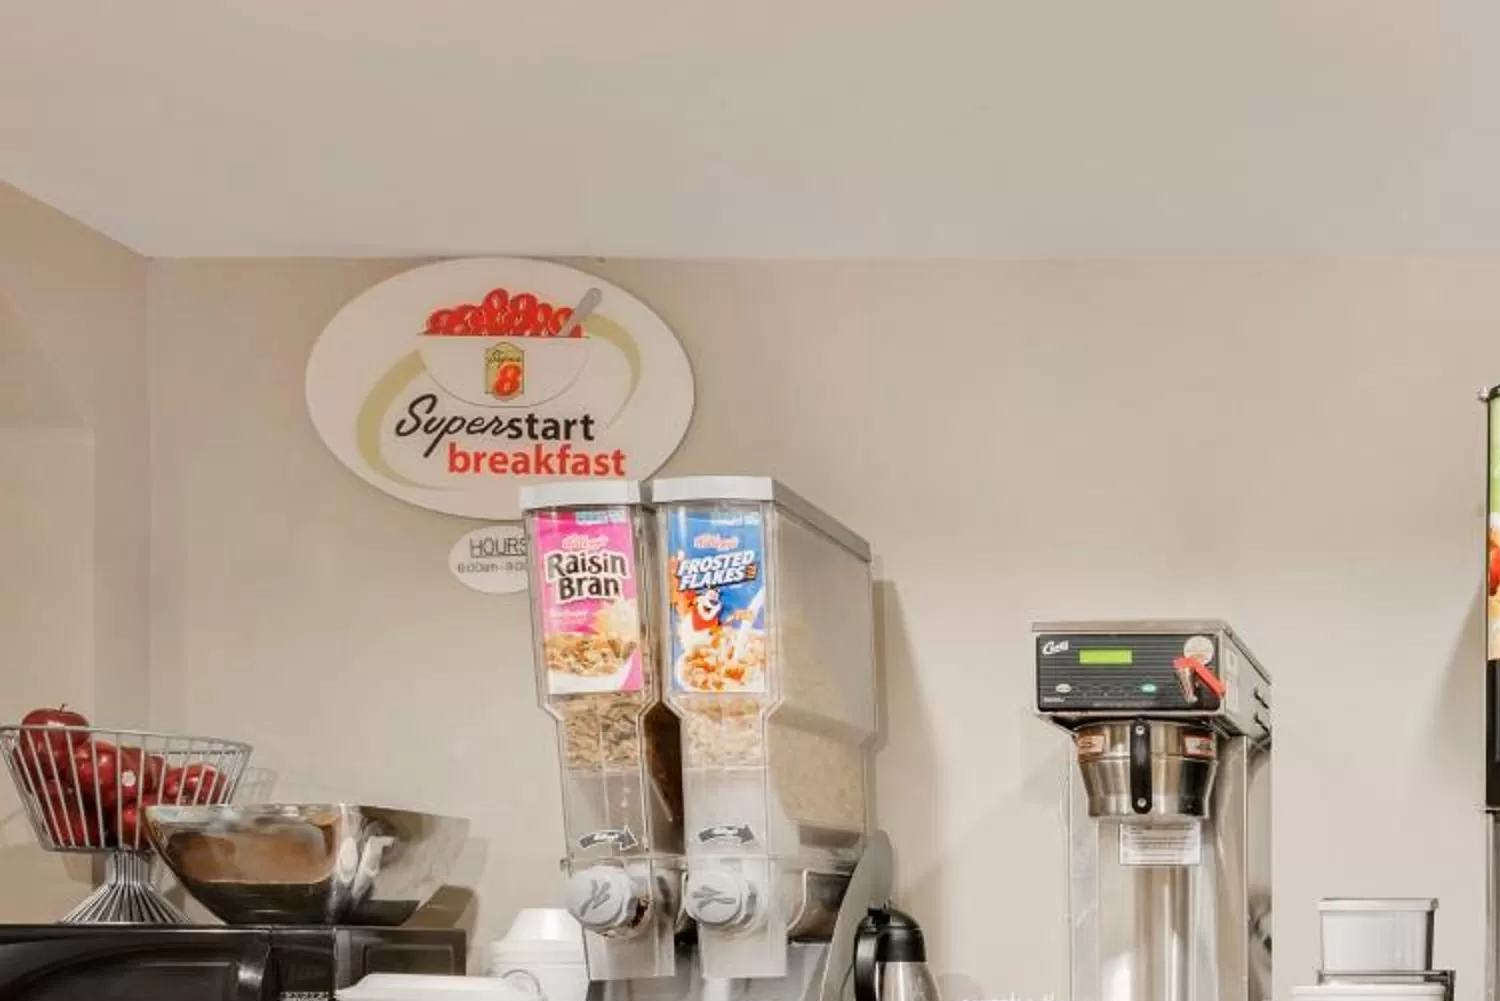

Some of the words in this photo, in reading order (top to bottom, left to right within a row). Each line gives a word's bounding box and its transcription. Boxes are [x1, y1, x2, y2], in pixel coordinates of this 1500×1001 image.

[448, 441, 627, 476] breakfast
[546, 552, 627, 581] Raisin
[678, 550, 755, 577] FROSTED
[559, 576, 619, 600] Bran
[679, 565, 746, 592] FLAKES
